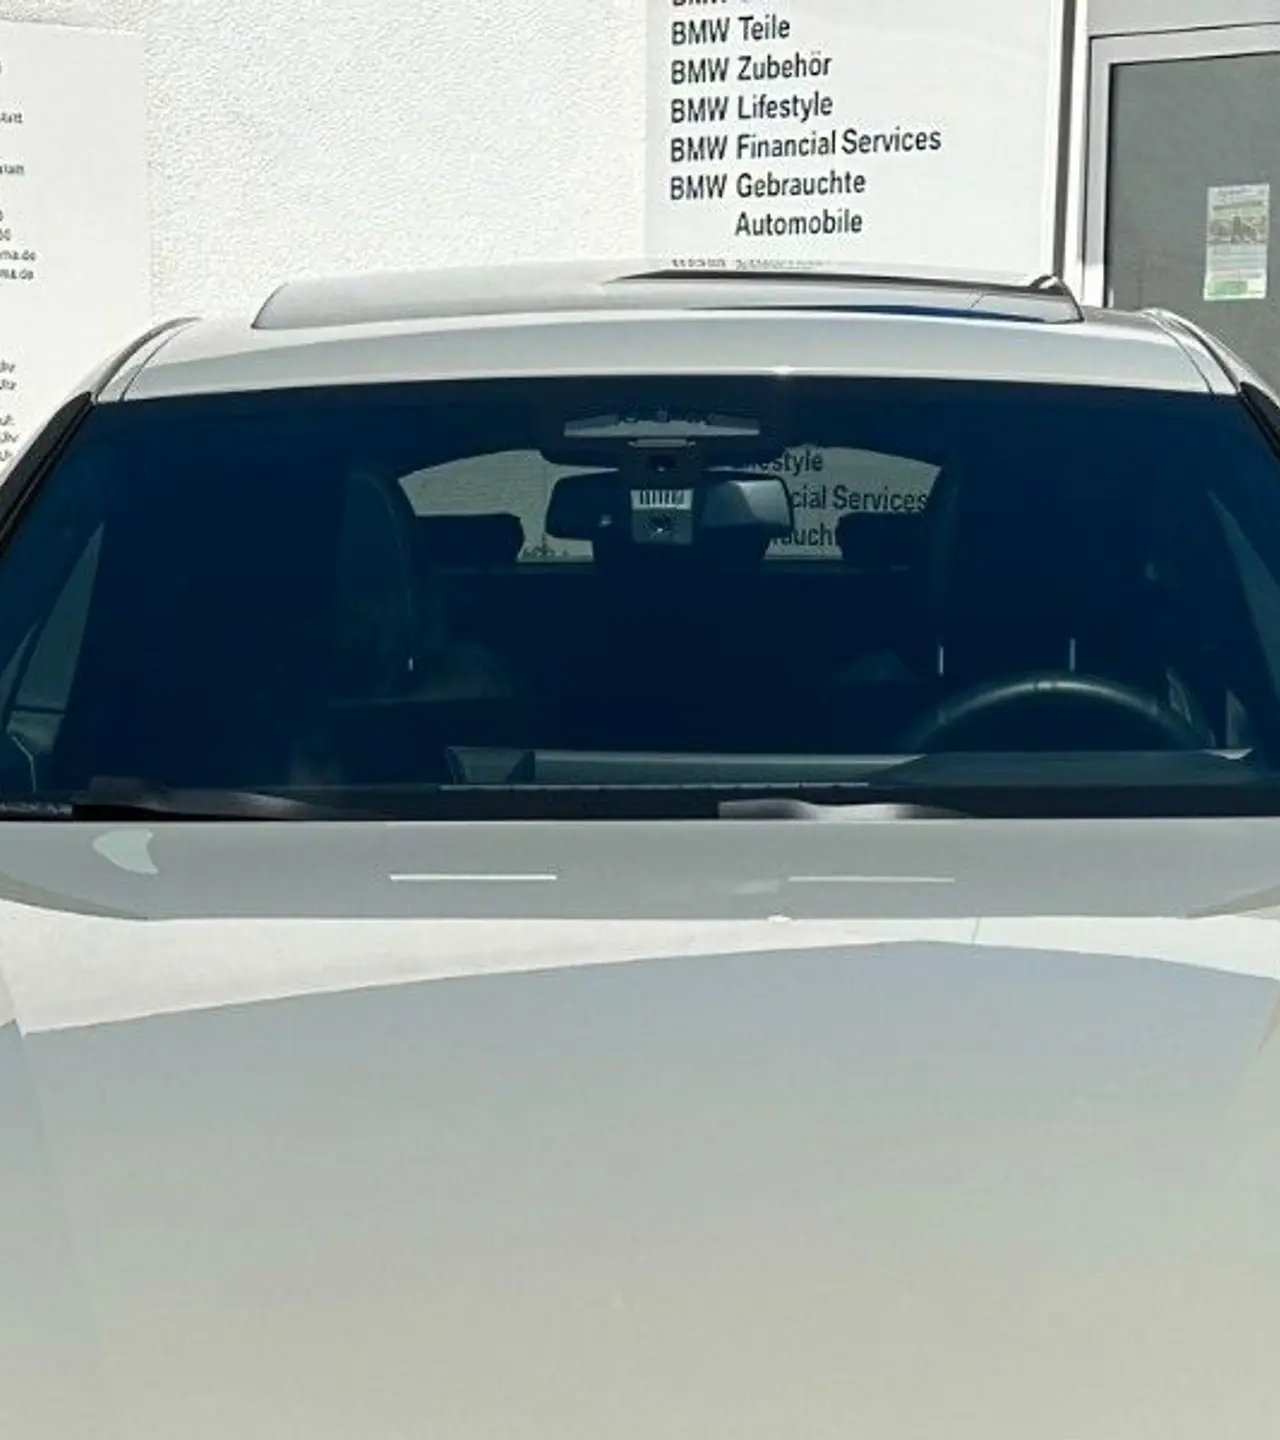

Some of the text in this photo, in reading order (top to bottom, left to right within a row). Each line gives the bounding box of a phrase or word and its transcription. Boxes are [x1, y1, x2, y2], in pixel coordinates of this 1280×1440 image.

[671, 14, 790, 45] BMW Teile
[671, 50, 832, 84] BMW Zubehör
[671, 90, 833, 123] BMW Lifestyle
[671, 126, 942, 162] BMW Financial Services
[670, 170, 866, 201] BMW Gebrauchte
[735, 208, 863, 237] Automobile
[832, 484, 928, 511] Services
